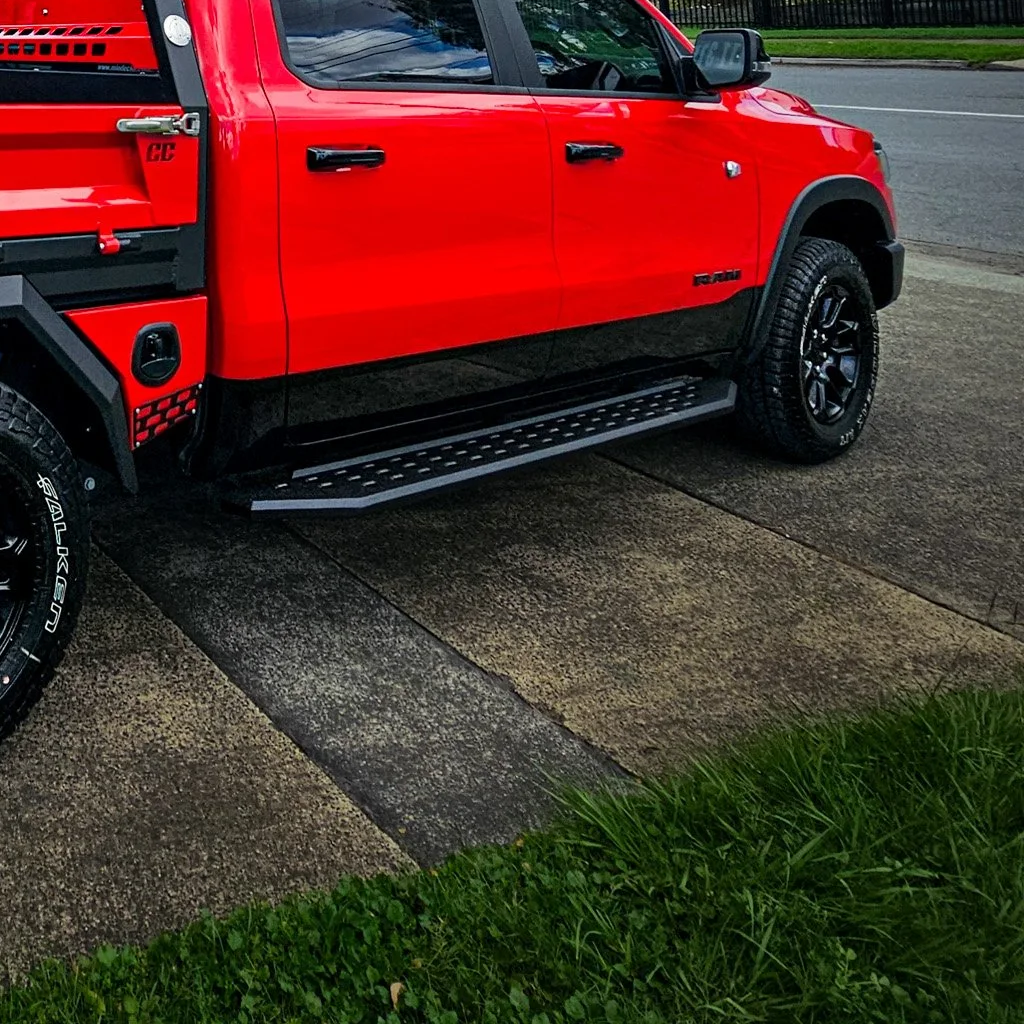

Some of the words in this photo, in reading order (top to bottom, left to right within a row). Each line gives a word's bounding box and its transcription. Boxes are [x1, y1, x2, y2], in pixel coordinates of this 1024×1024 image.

[146, 142, 176, 162] CC
[692, 269, 741, 287] RAM
[36, 471, 69, 634] FALKEN
